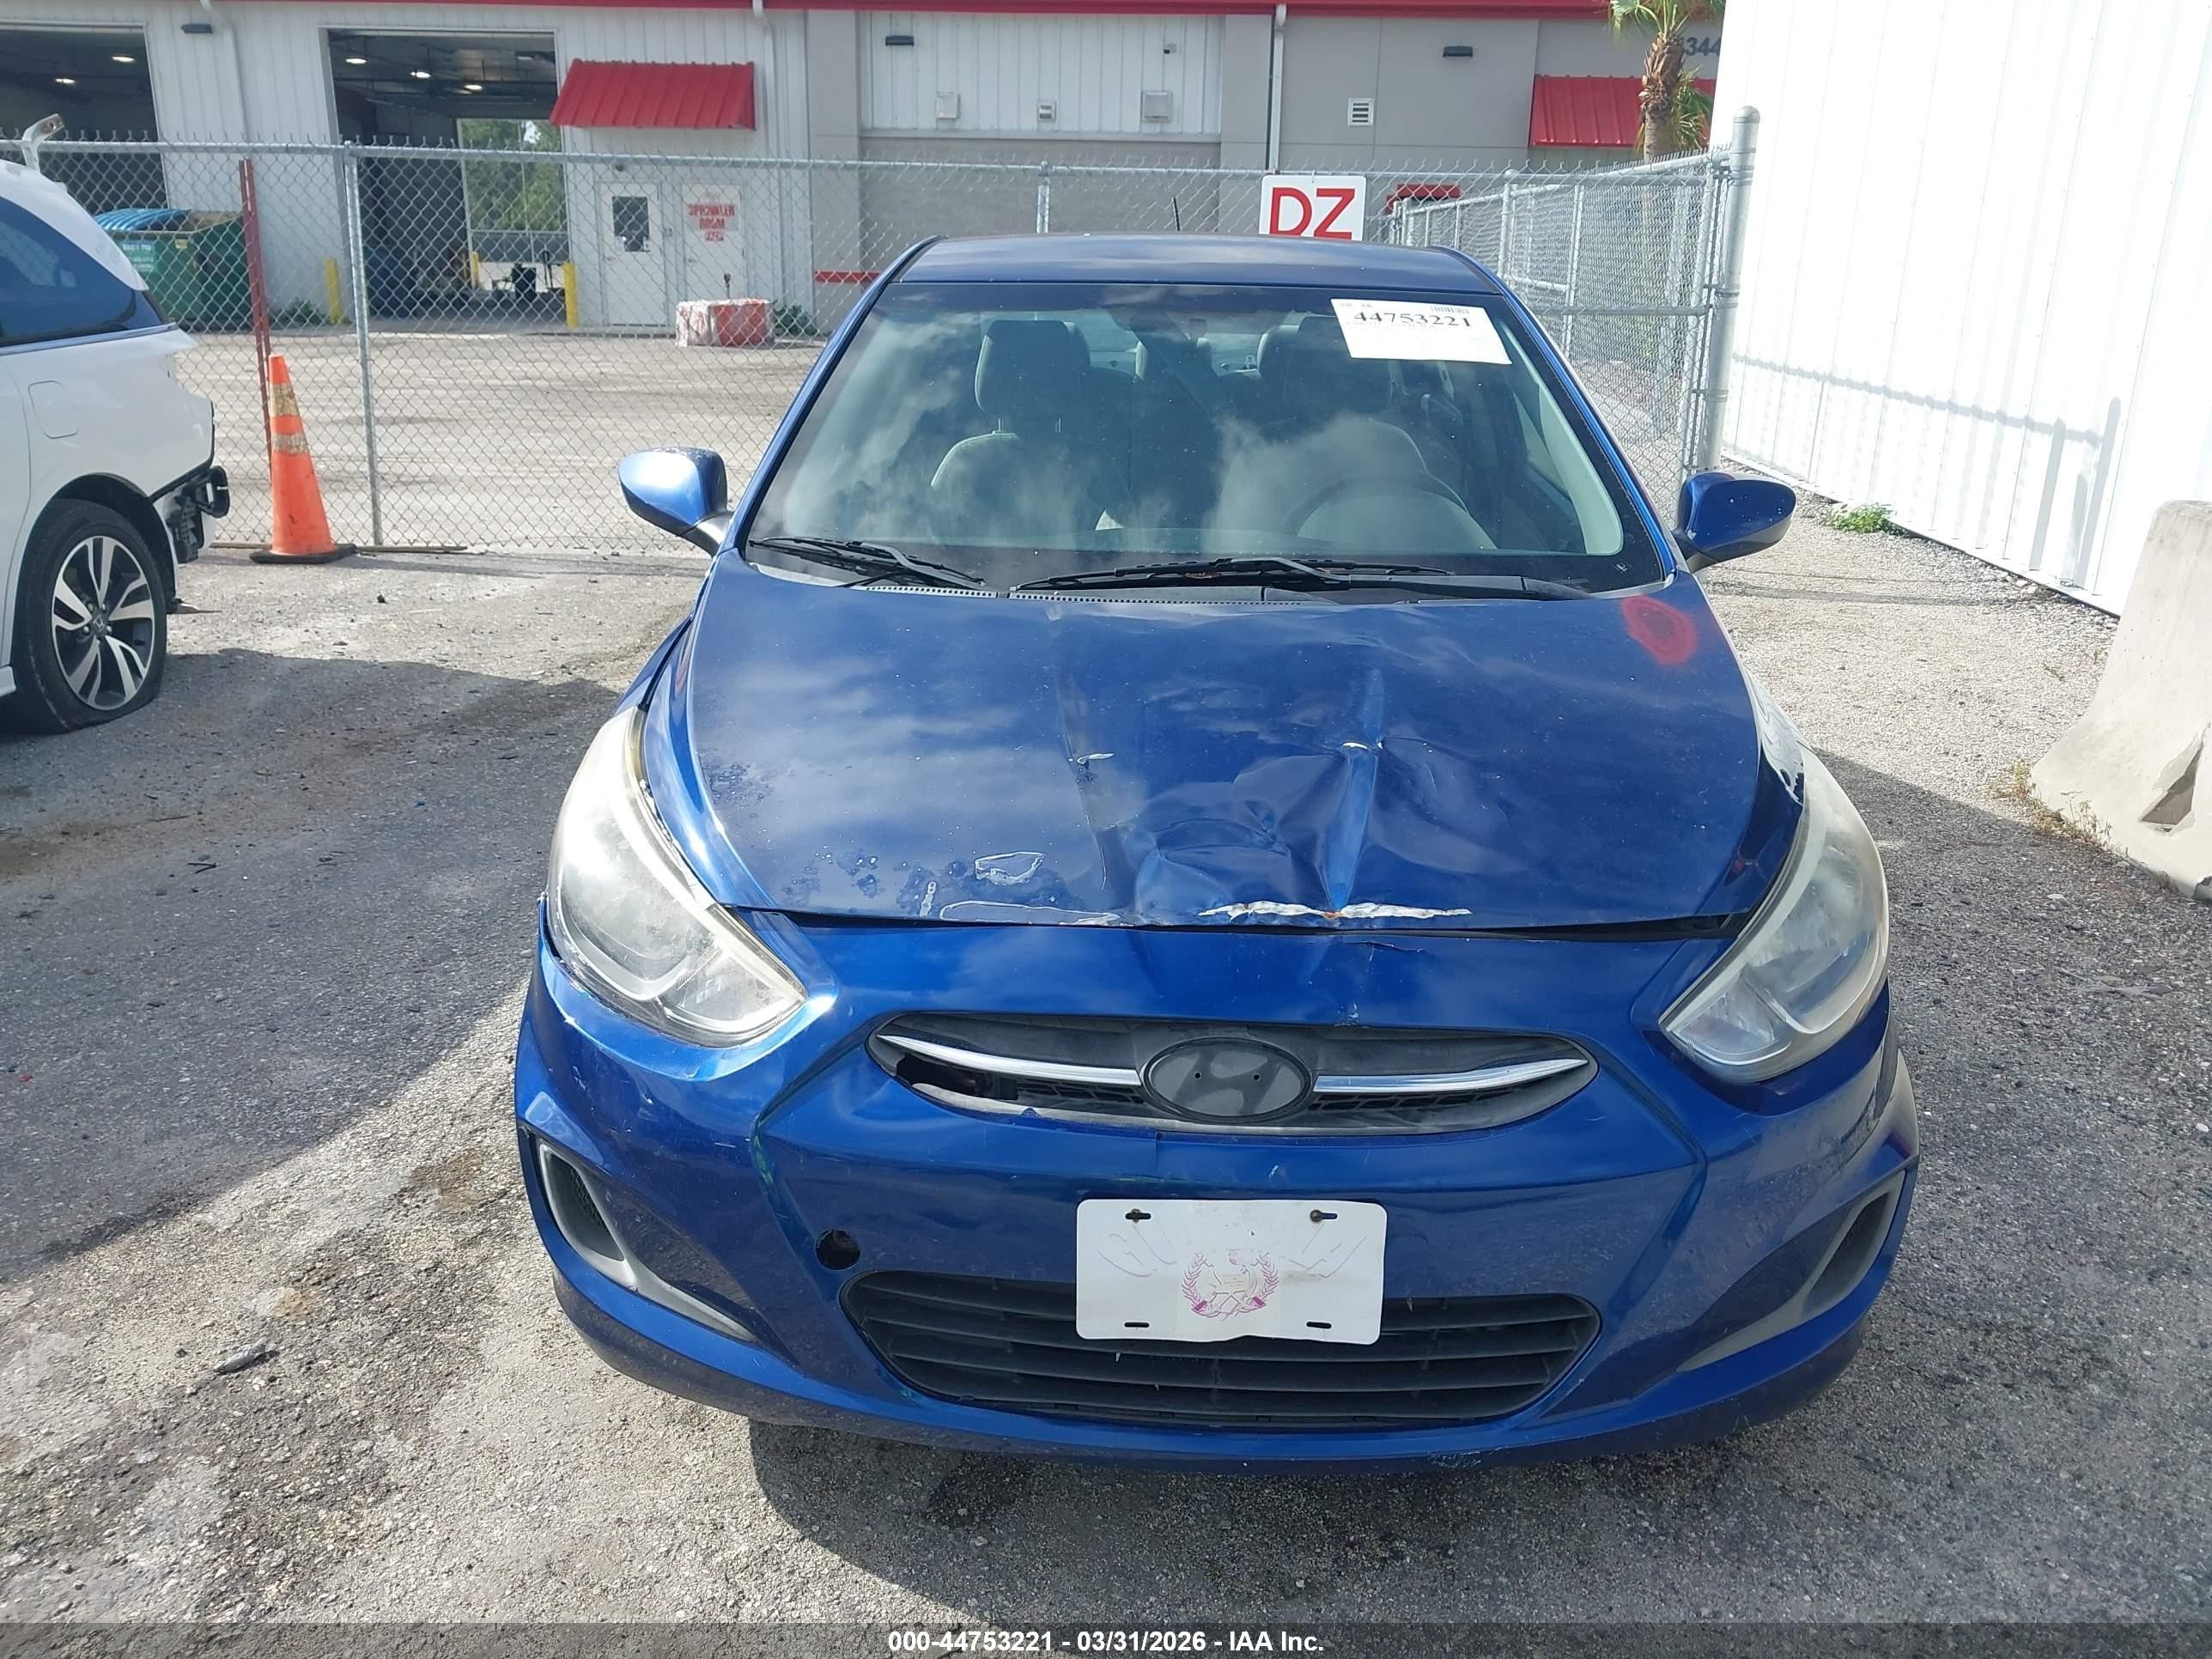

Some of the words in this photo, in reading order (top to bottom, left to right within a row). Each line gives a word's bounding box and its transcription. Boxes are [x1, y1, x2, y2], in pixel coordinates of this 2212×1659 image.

[1674, 37, 1721, 56] 344
[1269, 186, 1356, 240] DZ
[1353, 311, 1472, 328] 44753221
